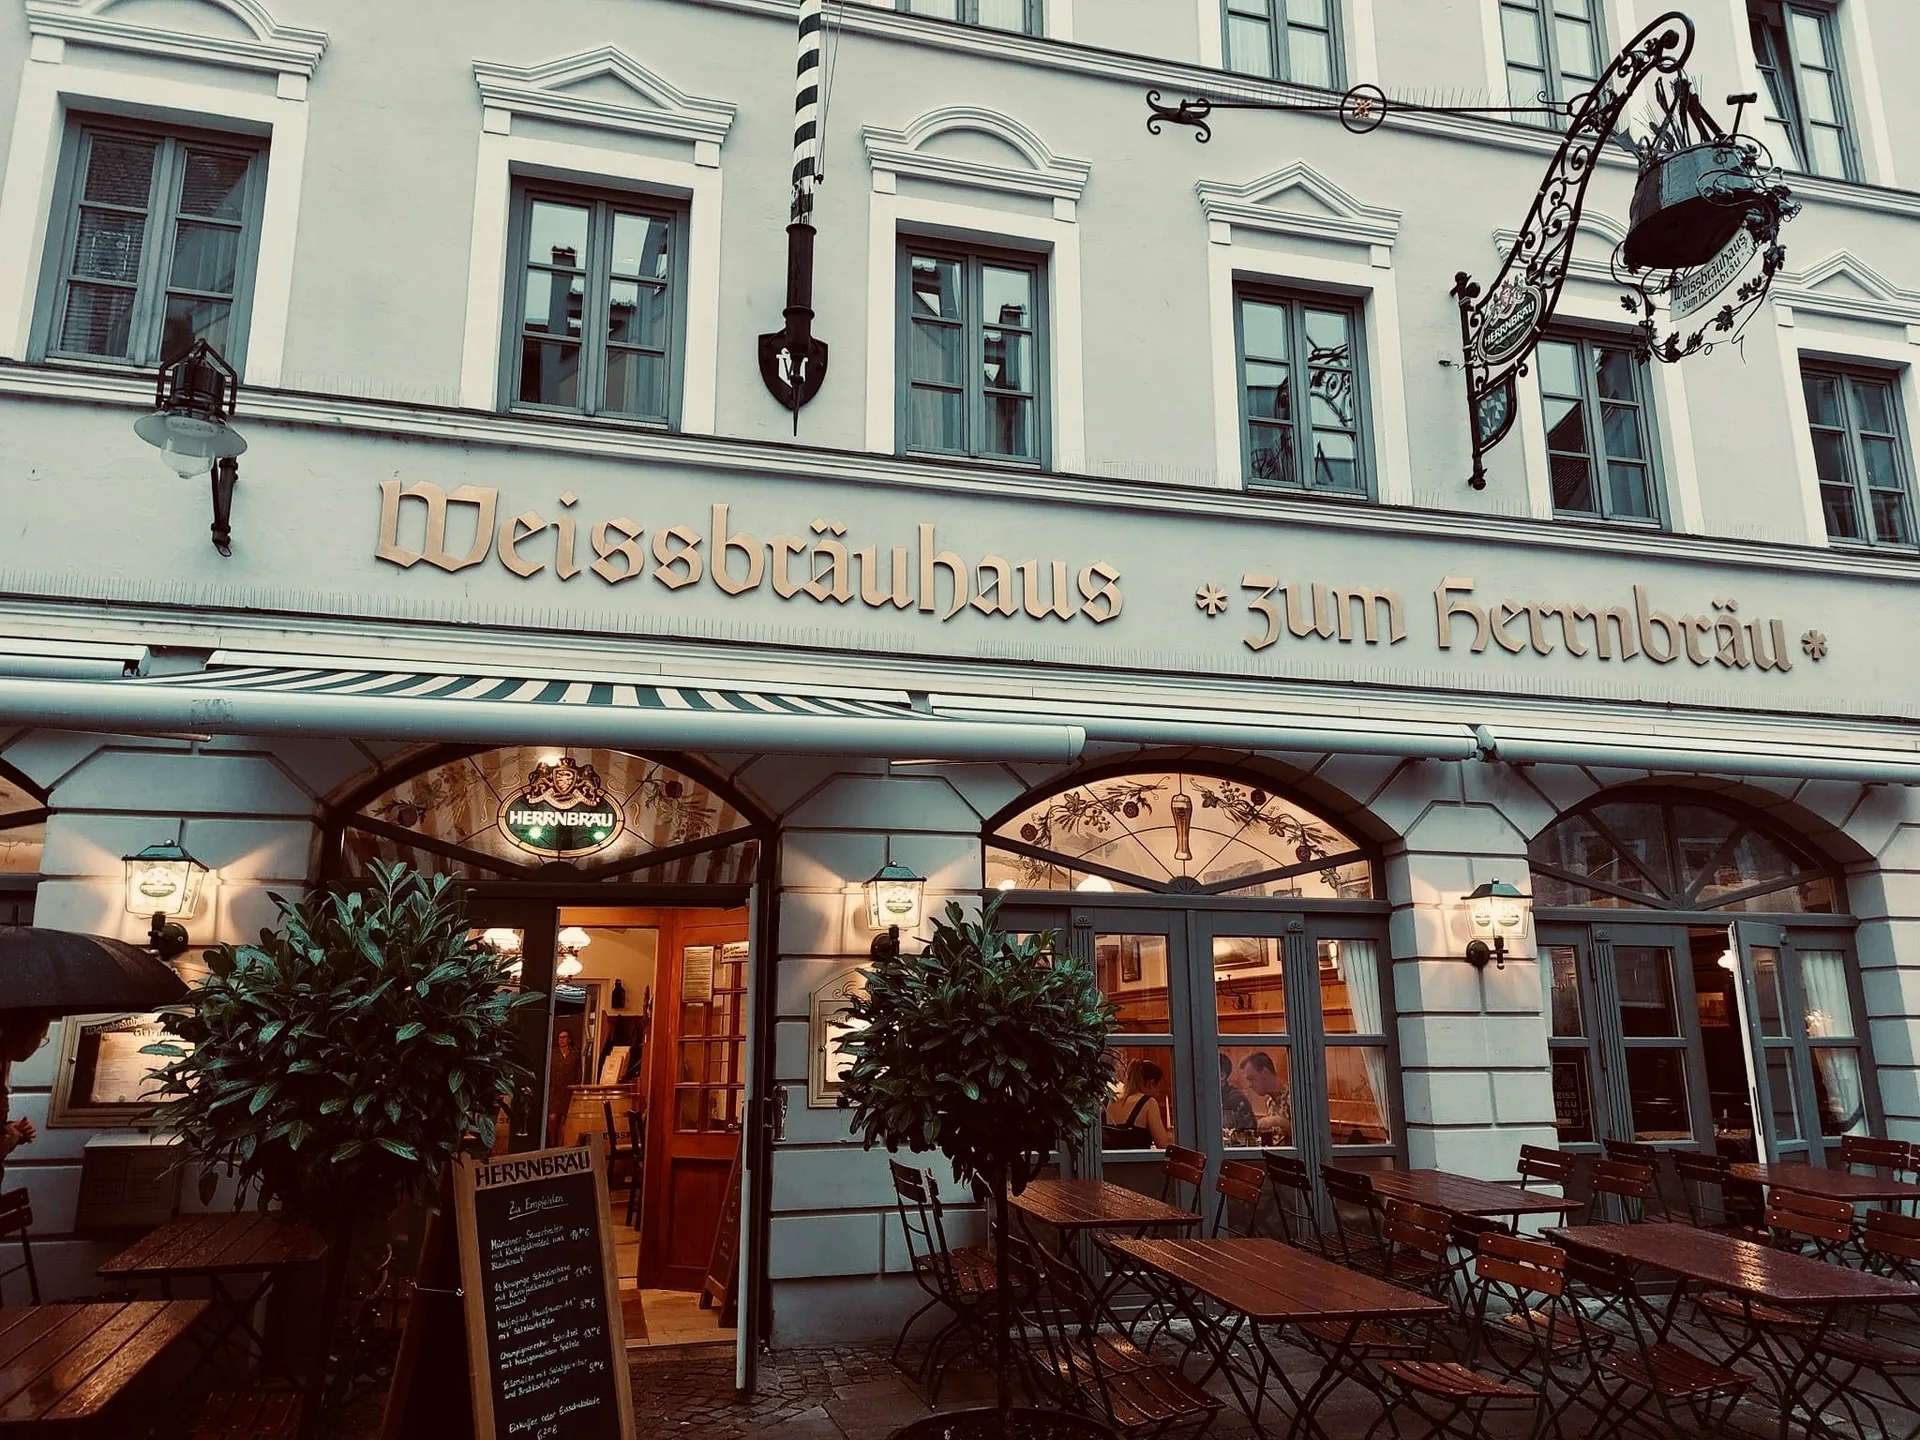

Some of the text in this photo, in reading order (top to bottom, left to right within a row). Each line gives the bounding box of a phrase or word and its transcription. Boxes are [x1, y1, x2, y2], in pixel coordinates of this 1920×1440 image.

[1674, 233, 1746, 300] Weissbräuhaus
[1484, 300, 1535, 347] HERRNBRÄU
[374, 480, 1124, 623] Weissbräuhaus
[1435, 575, 1793, 673] Herrnbräu
[509, 810, 613, 828] HERRNBRÄU
[1556, 1091, 1577, 1100] EISS
[475, 1150, 590, 1187] HERRNBRÄU
[509, 1200, 521, 1215] Zu
[541, 1411, 556, 1423] oder
